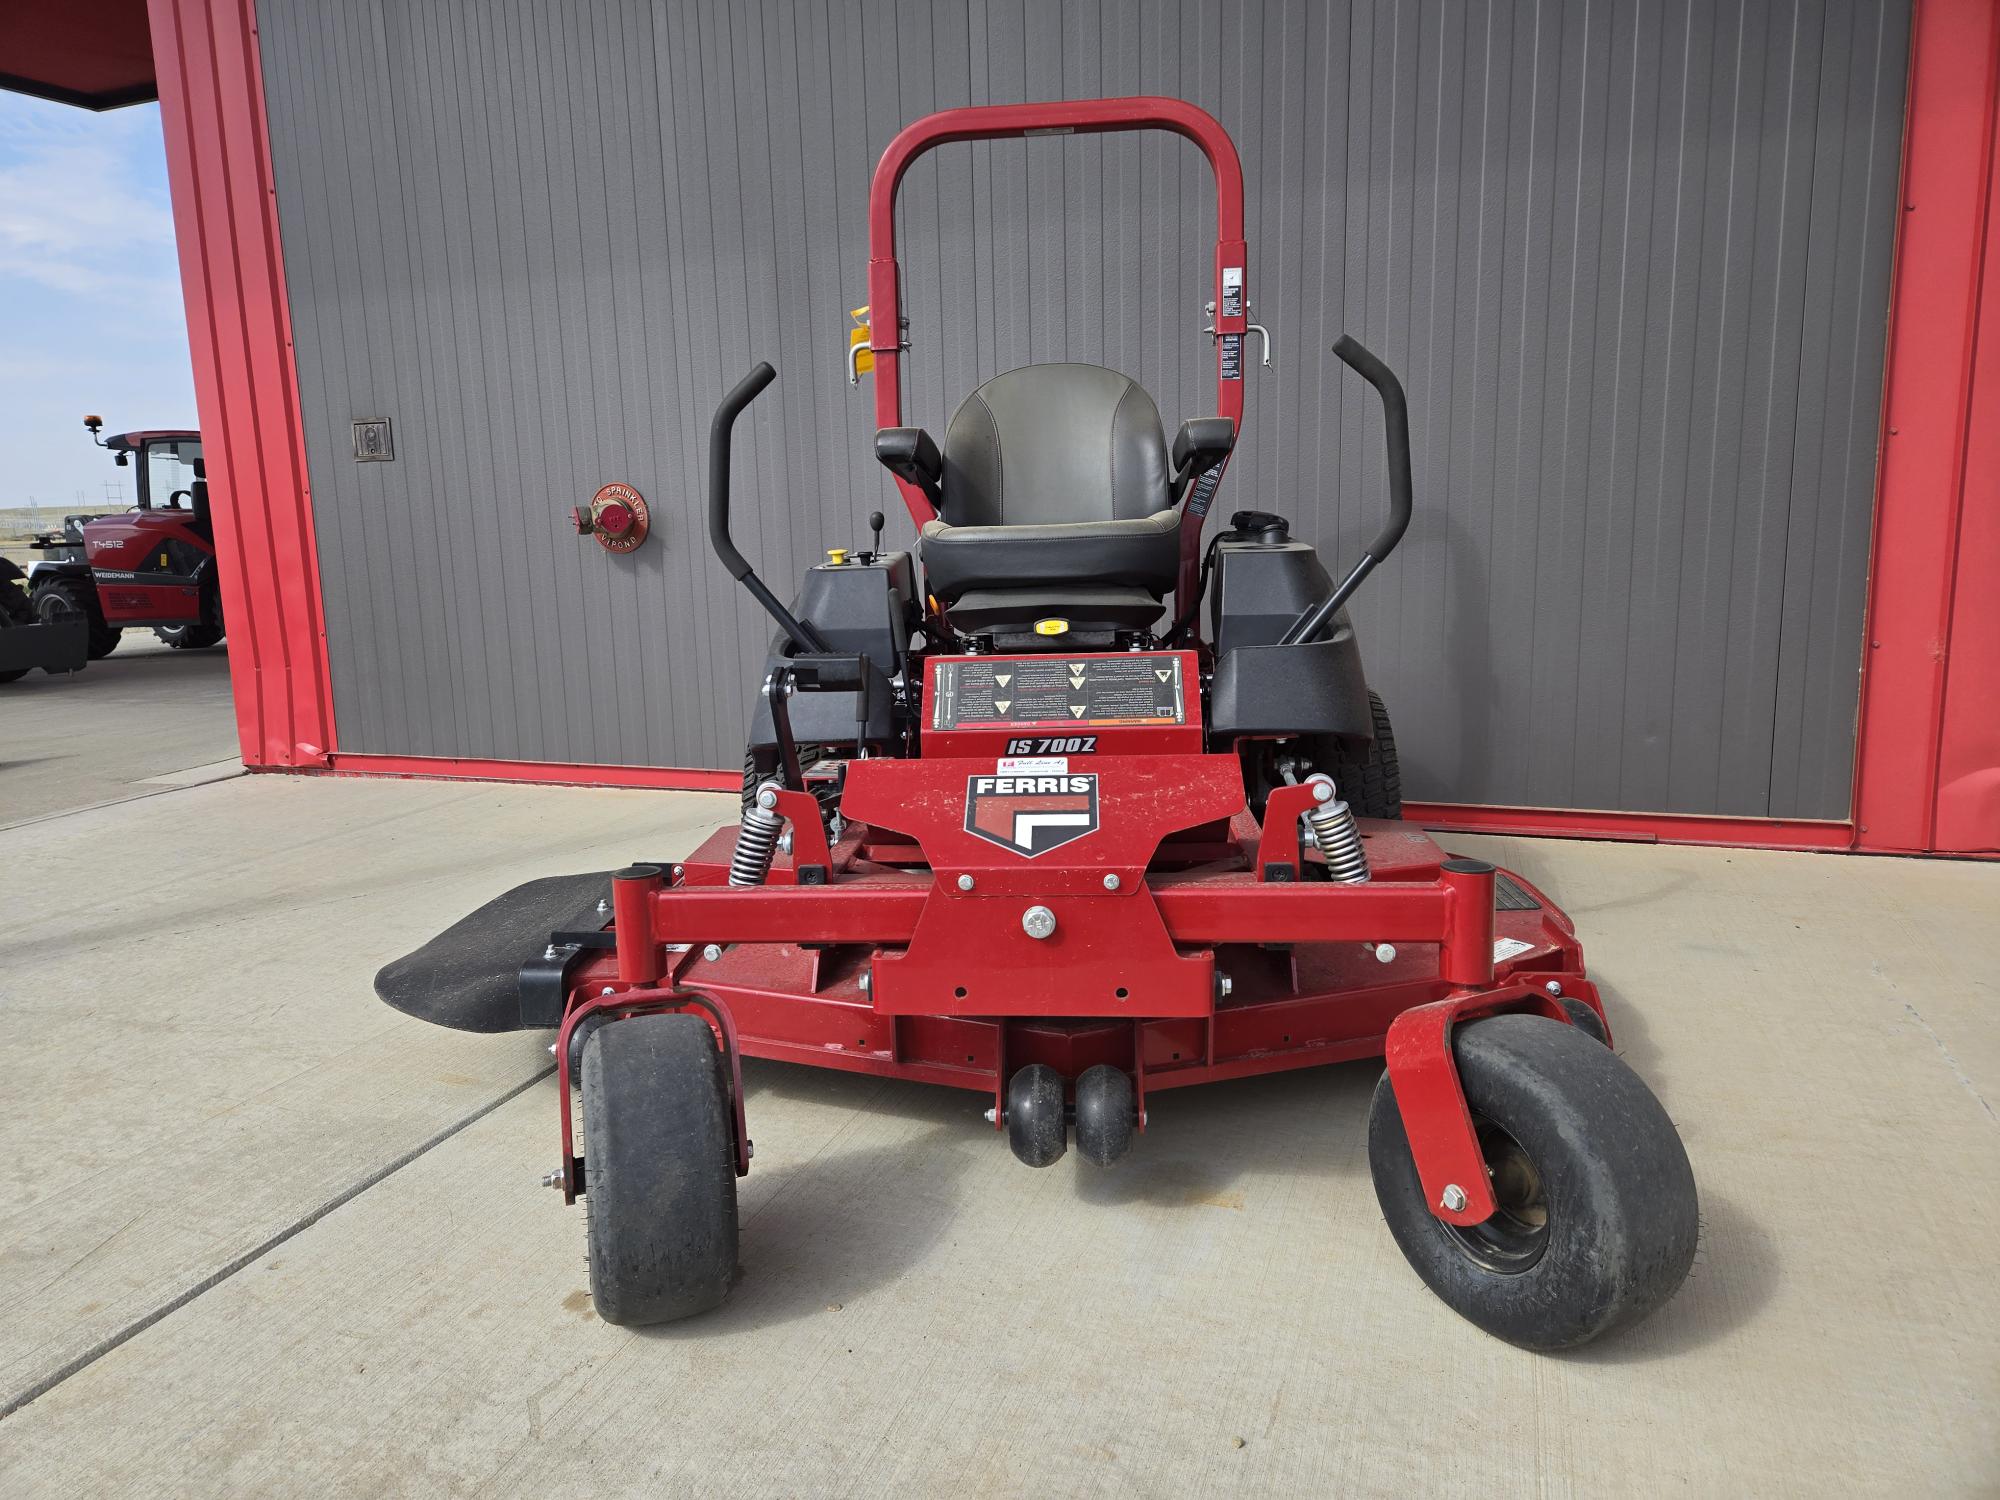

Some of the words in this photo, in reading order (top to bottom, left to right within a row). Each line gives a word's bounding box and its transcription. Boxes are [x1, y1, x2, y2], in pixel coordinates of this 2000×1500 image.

[607, 487, 644, 520] SPRINKLER
[602, 534, 636, 548] VIPOND
[1007, 739, 1031, 755] IS
[1036, 736, 1097, 754] 700Z
[976, 776, 1090, 794] FERRIS
